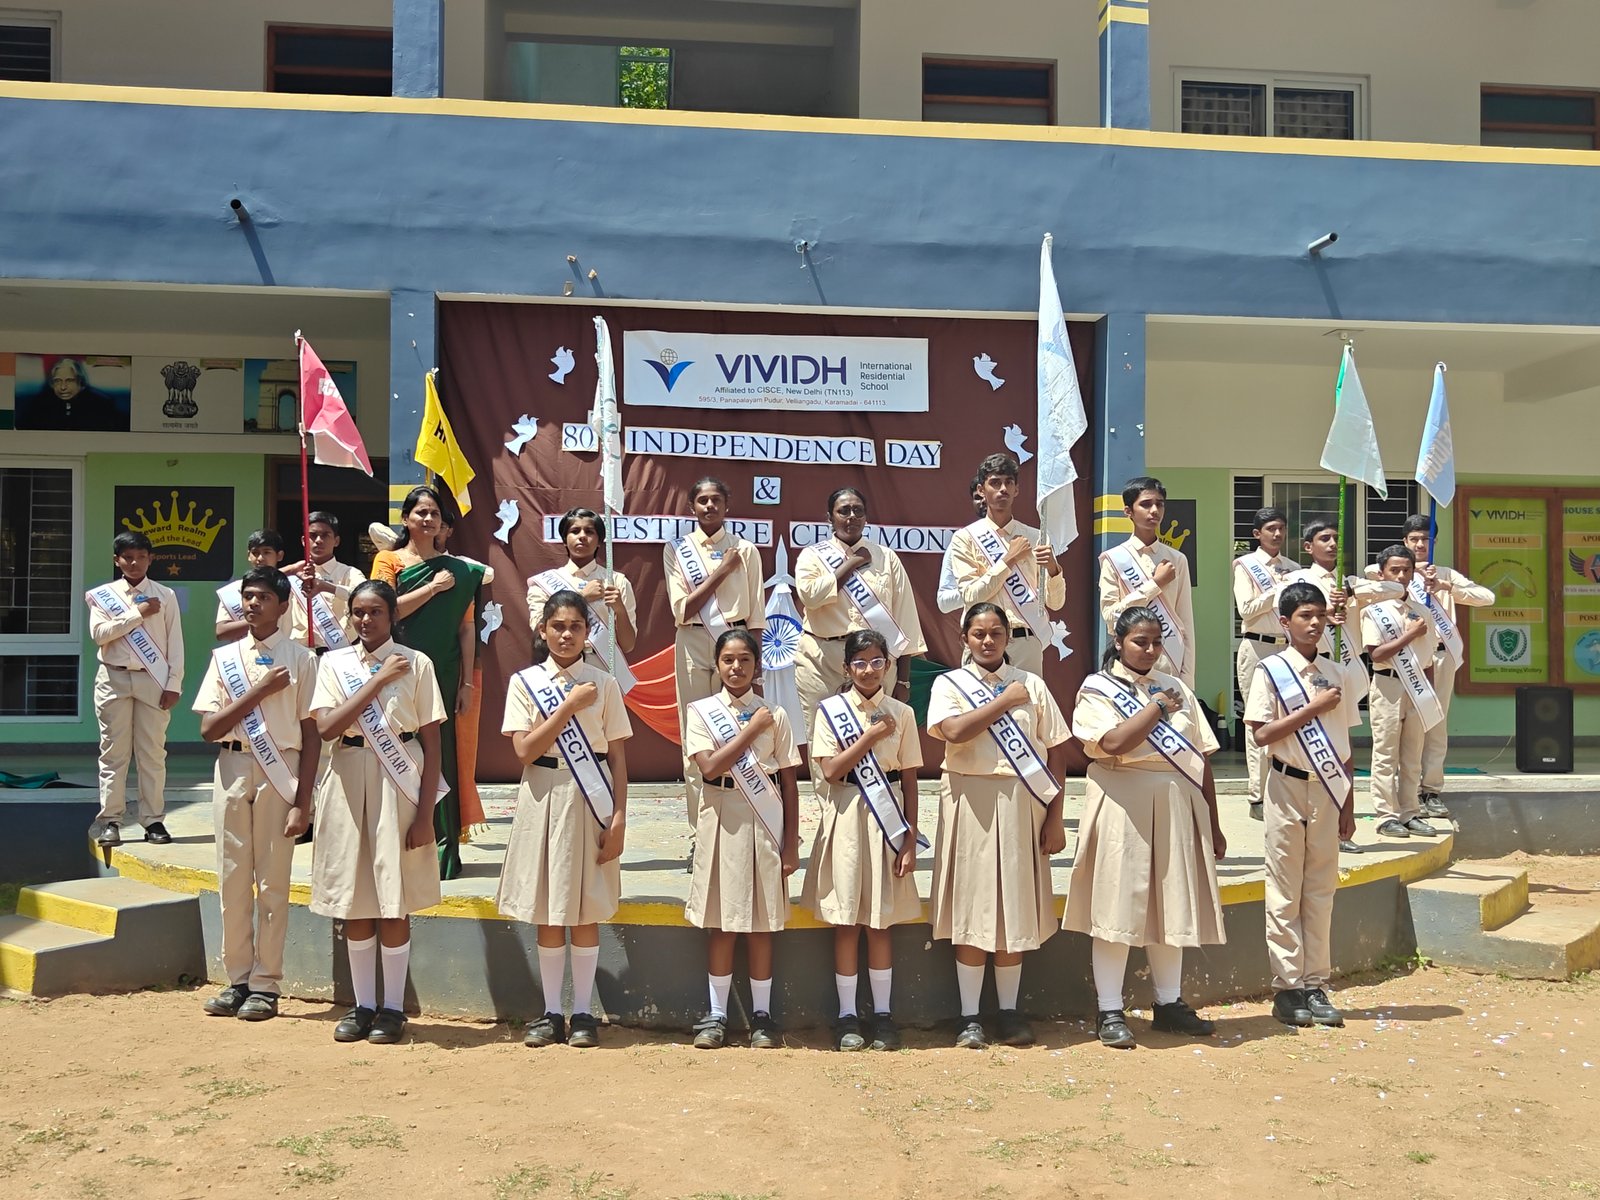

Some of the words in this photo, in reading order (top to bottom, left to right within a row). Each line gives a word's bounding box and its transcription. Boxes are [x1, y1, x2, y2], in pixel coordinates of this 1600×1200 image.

[715, 354, 846, 385] VIVIDH
[860, 362, 912, 371] International
[860, 372, 905, 380] Residential
[715, 386, 745, 394] Affiliated
[757, 386, 784, 395] CISCE,
[804, 388, 822, 396] Delhi
[824, 388, 853, 397] (TN113)
[824, 398, 859, 406] Karamadai
[860, 382, 888, 391] School
[564, 425, 594, 449] 80
[631, 430, 873, 463] INDEPENDENCE
[887, 442, 942, 466] DAY
[755, 477, 778, 500] &
[143, 524, 172, 536] eward
[178, 524, 206, 537] Realm
[1486, 510, 1526, 520] VIVIDH
[182, 536, 202, 547] Lead
[550, 517, 770, 545] IESTITRE
[791, 522, 956, 551] CEMON
[977, 531, 1004, 564] HEA
[1006, 573, 1034, 607] BOY
[846, 573, 871, 608] IRL
[313, 607, 343, 644] ACHILLES
[1429, 604, 1454, 640] POSEIDON
[1400, 659, 1424, 695] ATHENA
[361, 703, 379, 723] RTS
[537, 686, 589, 763] PRECT
[708, 708, 726, 726] LIT.
[971, 689, 1030, 760] PRFECT
[1114, 692, 1187, 756] PRECT
[369, 723, 411, 775] SECRETARY
[834, 712, 881, 787] PREECT
[735, 752, 767, 796] ESIDENT
